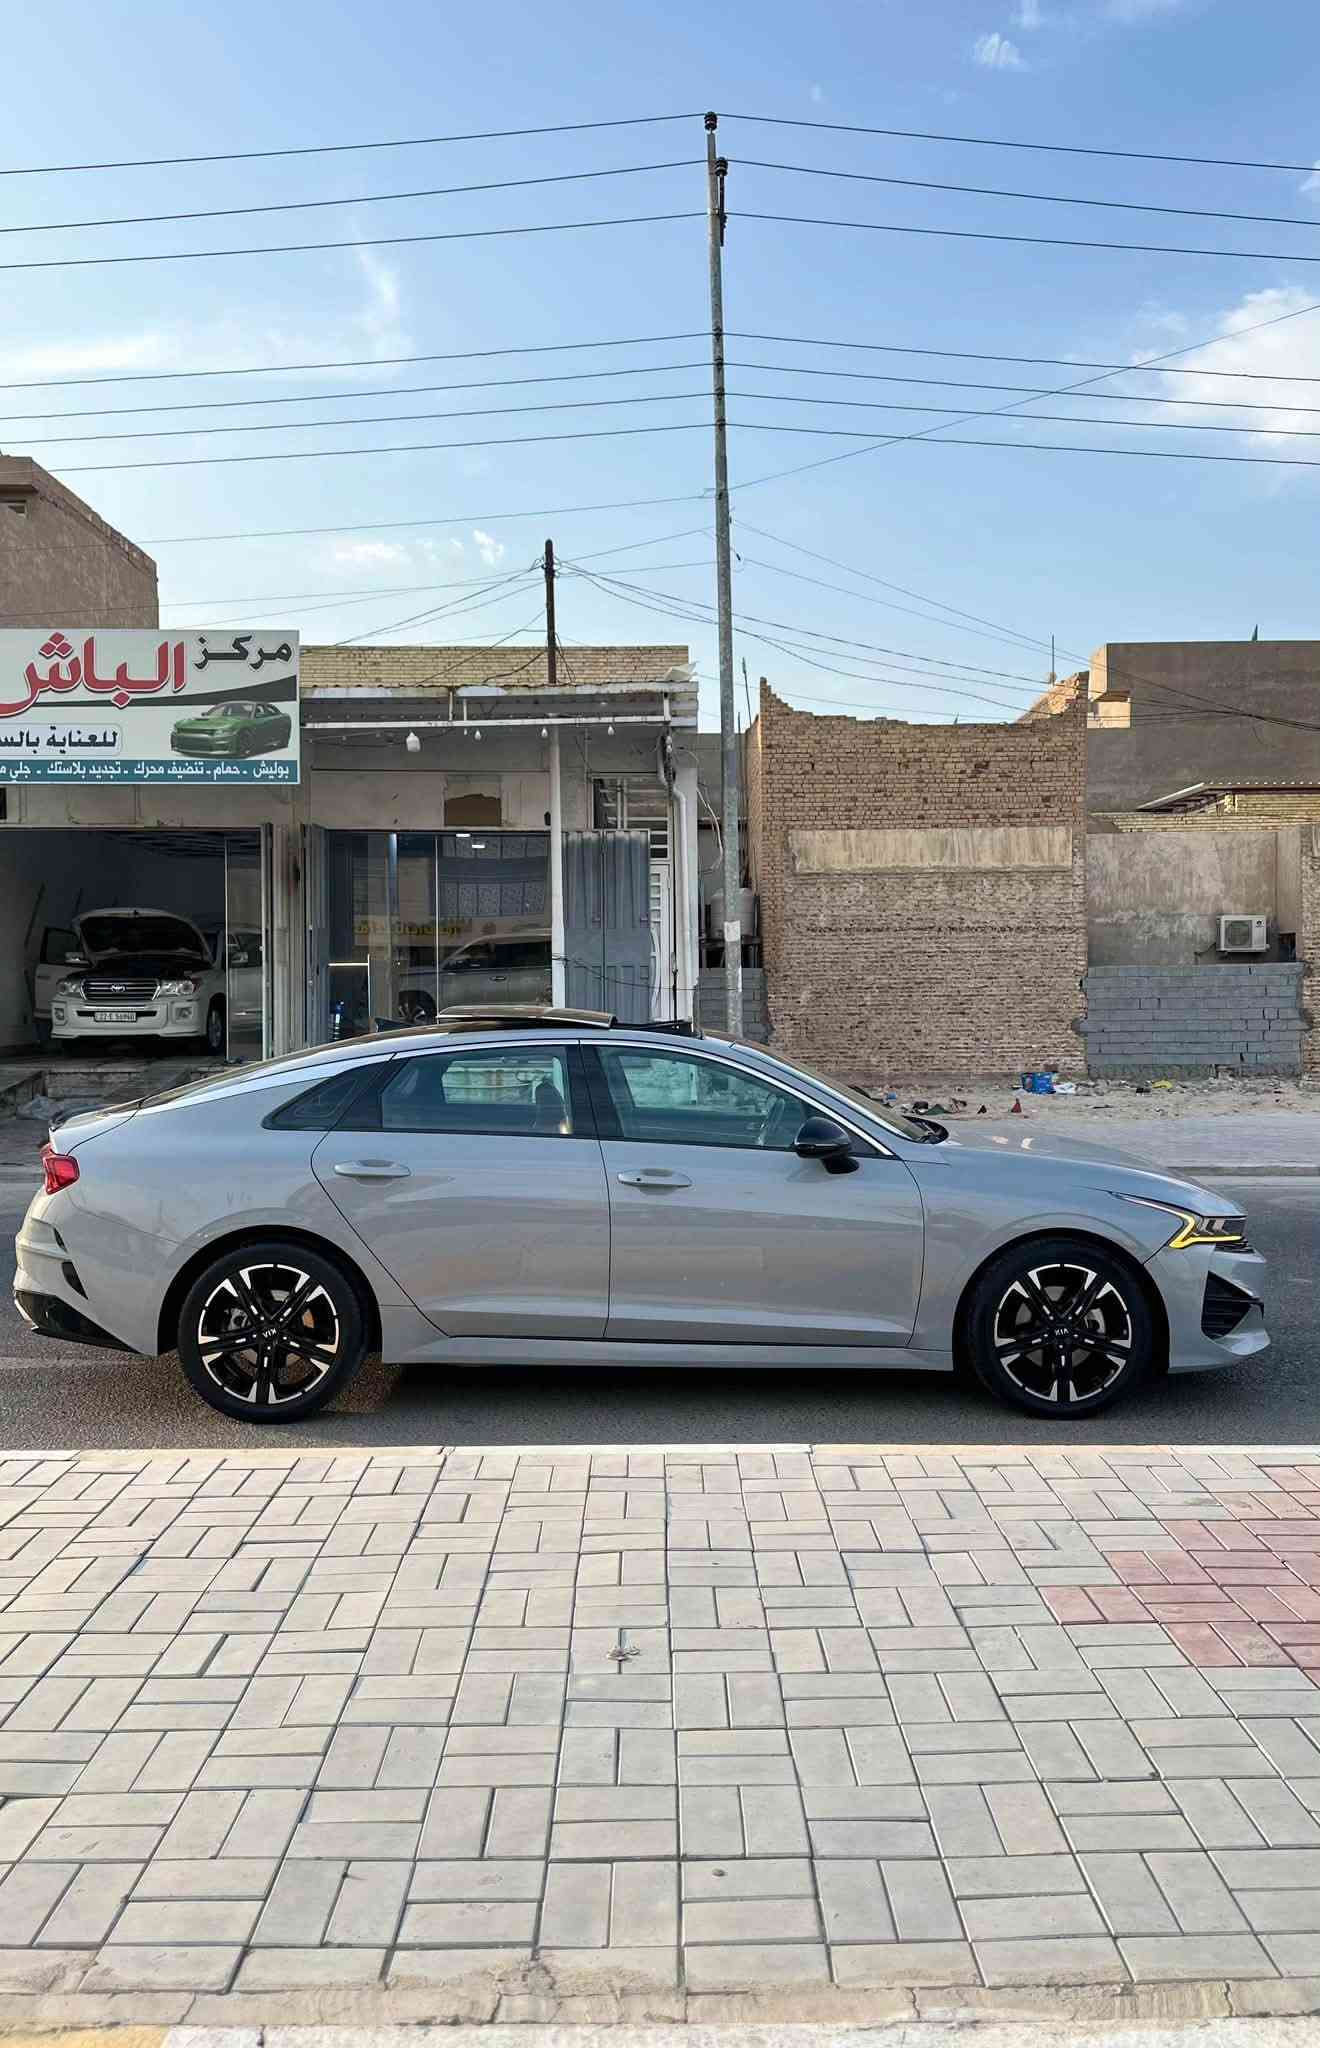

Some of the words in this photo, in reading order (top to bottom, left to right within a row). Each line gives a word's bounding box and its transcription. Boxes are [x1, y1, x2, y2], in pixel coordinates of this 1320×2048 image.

[193, 636, 292, 670] مركز
[46, 725, 117, 754] للعناية
[89, 761, 121, 779] تجديد
[134, 762, 164, 778] محرك
[213, 761, 240, 780] حمام
[253, 760, 290, 779] بوليش
